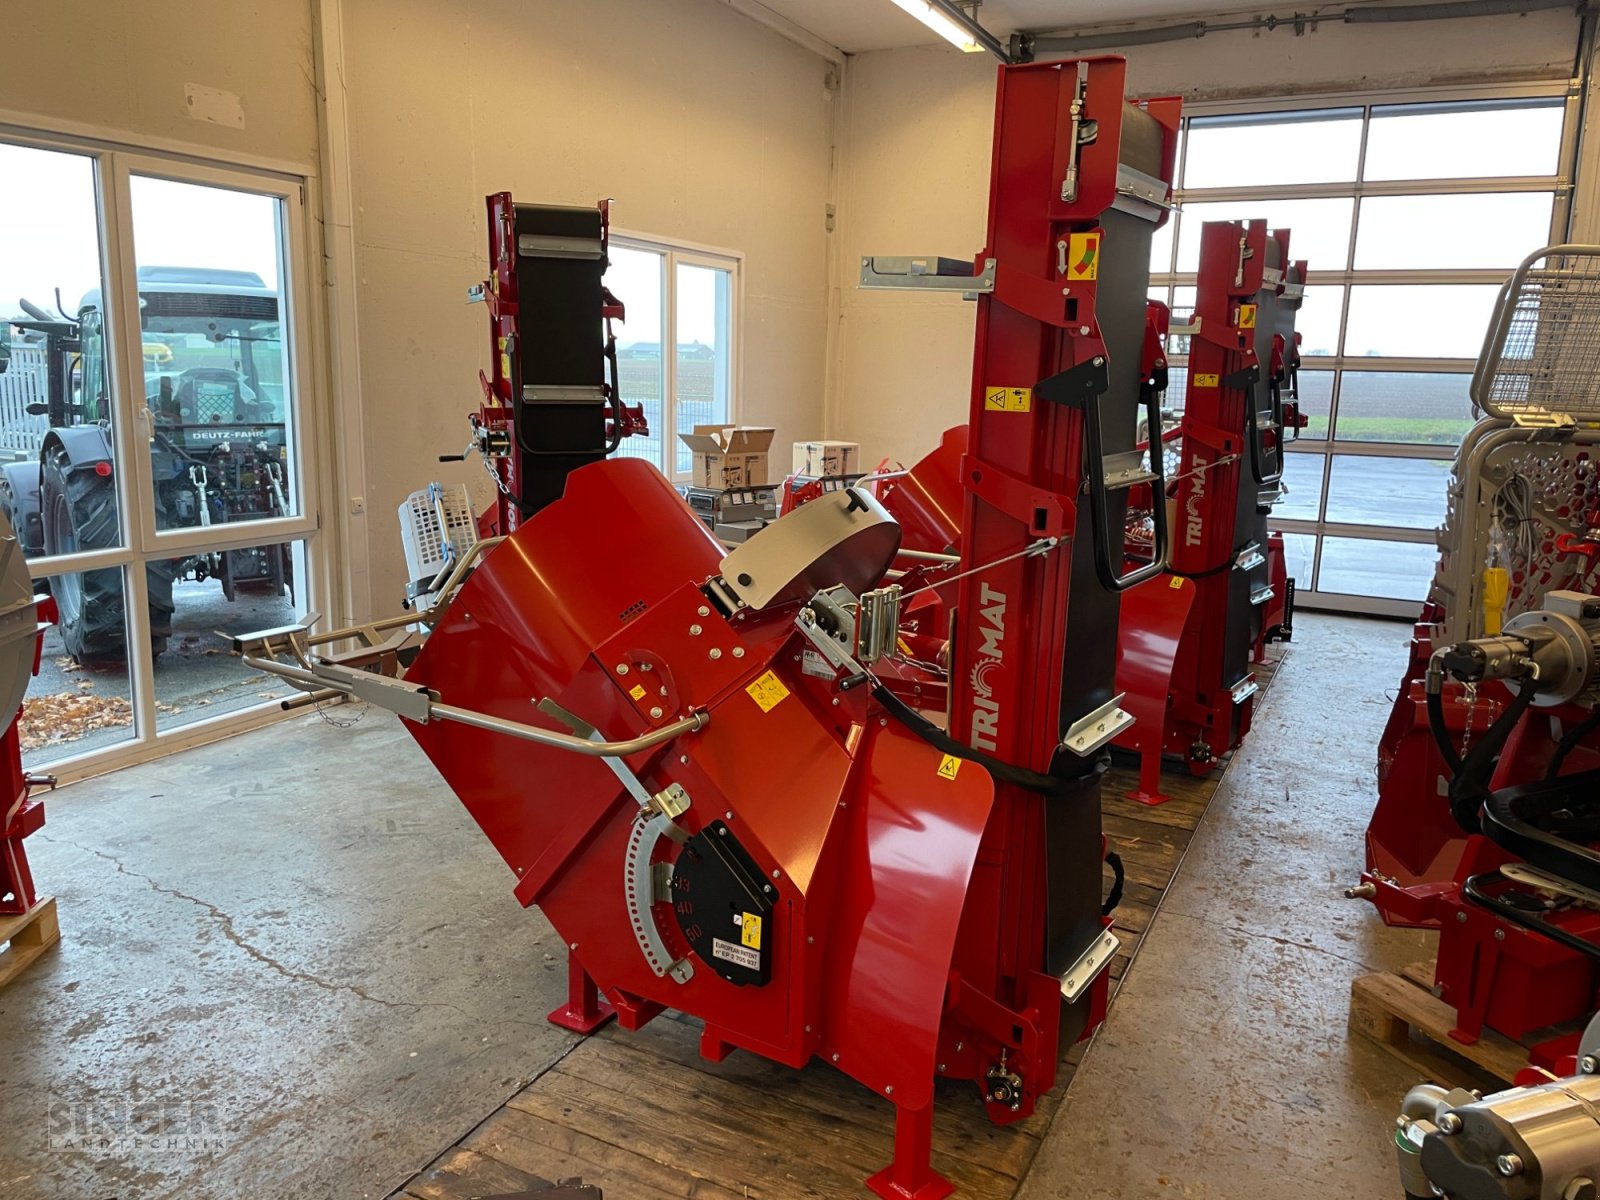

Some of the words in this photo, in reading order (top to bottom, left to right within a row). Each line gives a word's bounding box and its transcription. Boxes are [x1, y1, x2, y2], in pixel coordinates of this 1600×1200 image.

[192, 430, 264, 440] DEUTZ-FAHR
[677, 900, 693, 915] 40
[715, 941, 740, 955] EUROPEAN
[740, 948, 758, 961] PATENT
[736, 955, 746, 964] 705
